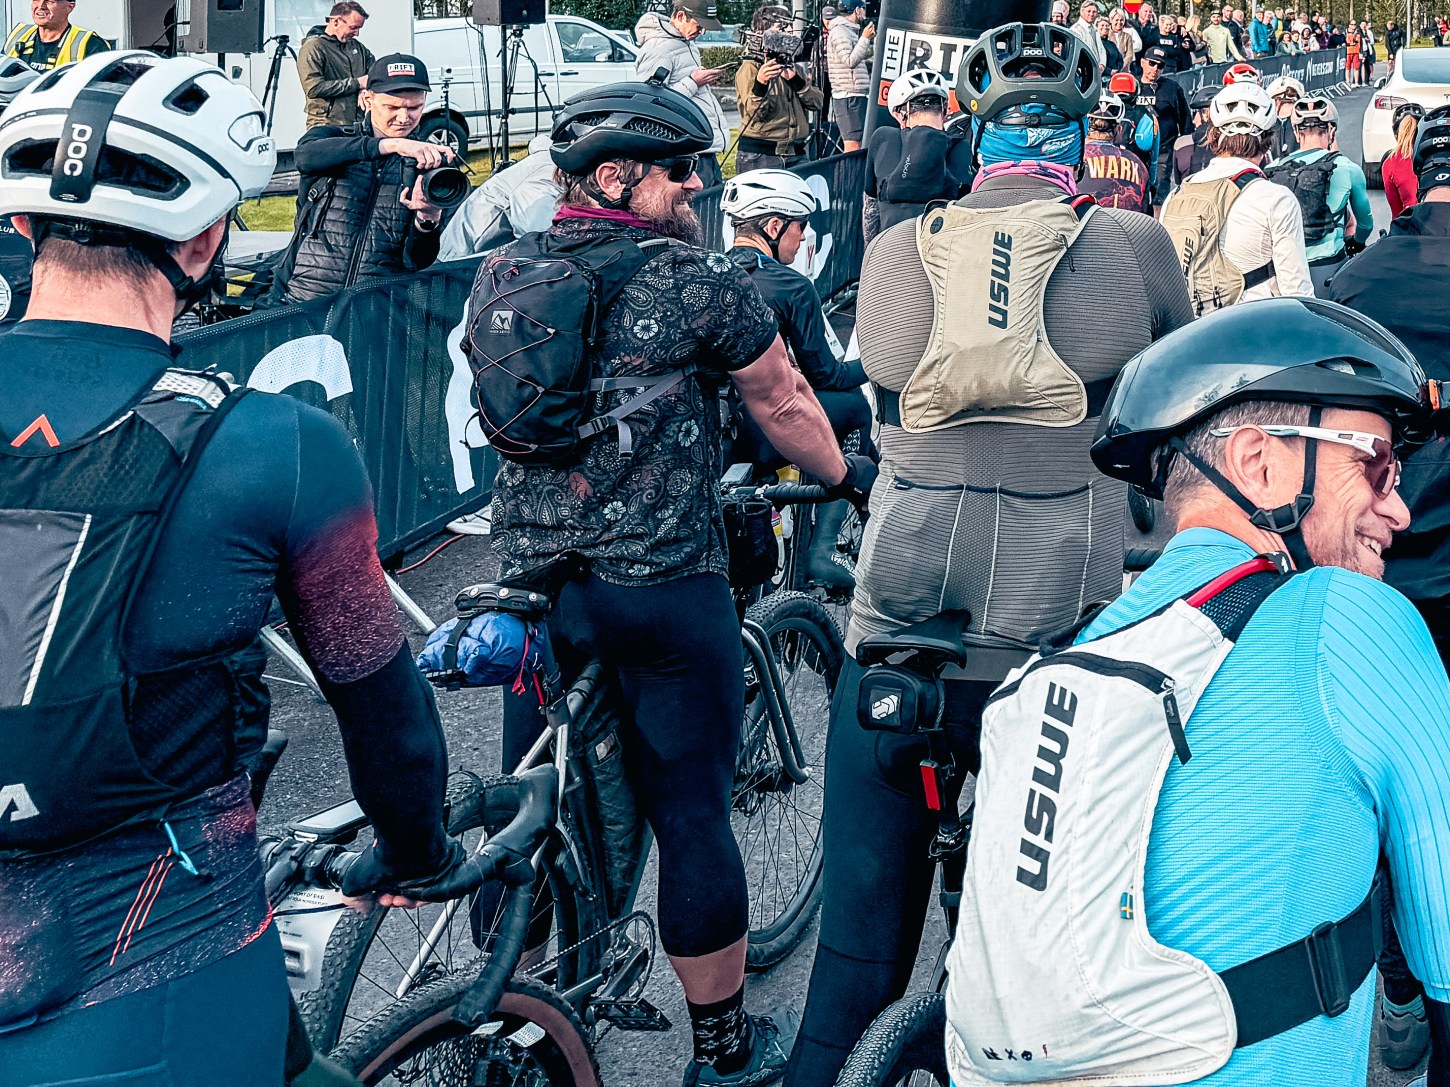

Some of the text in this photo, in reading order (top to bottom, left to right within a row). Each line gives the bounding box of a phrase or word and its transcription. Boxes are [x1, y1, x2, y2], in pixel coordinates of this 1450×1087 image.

[885, 34, 900, 73] THE
[908, 38, 972, 81] RI
[988, 231, 1013, 330] USWE
[1016, 681, 1078, 892] USWE
